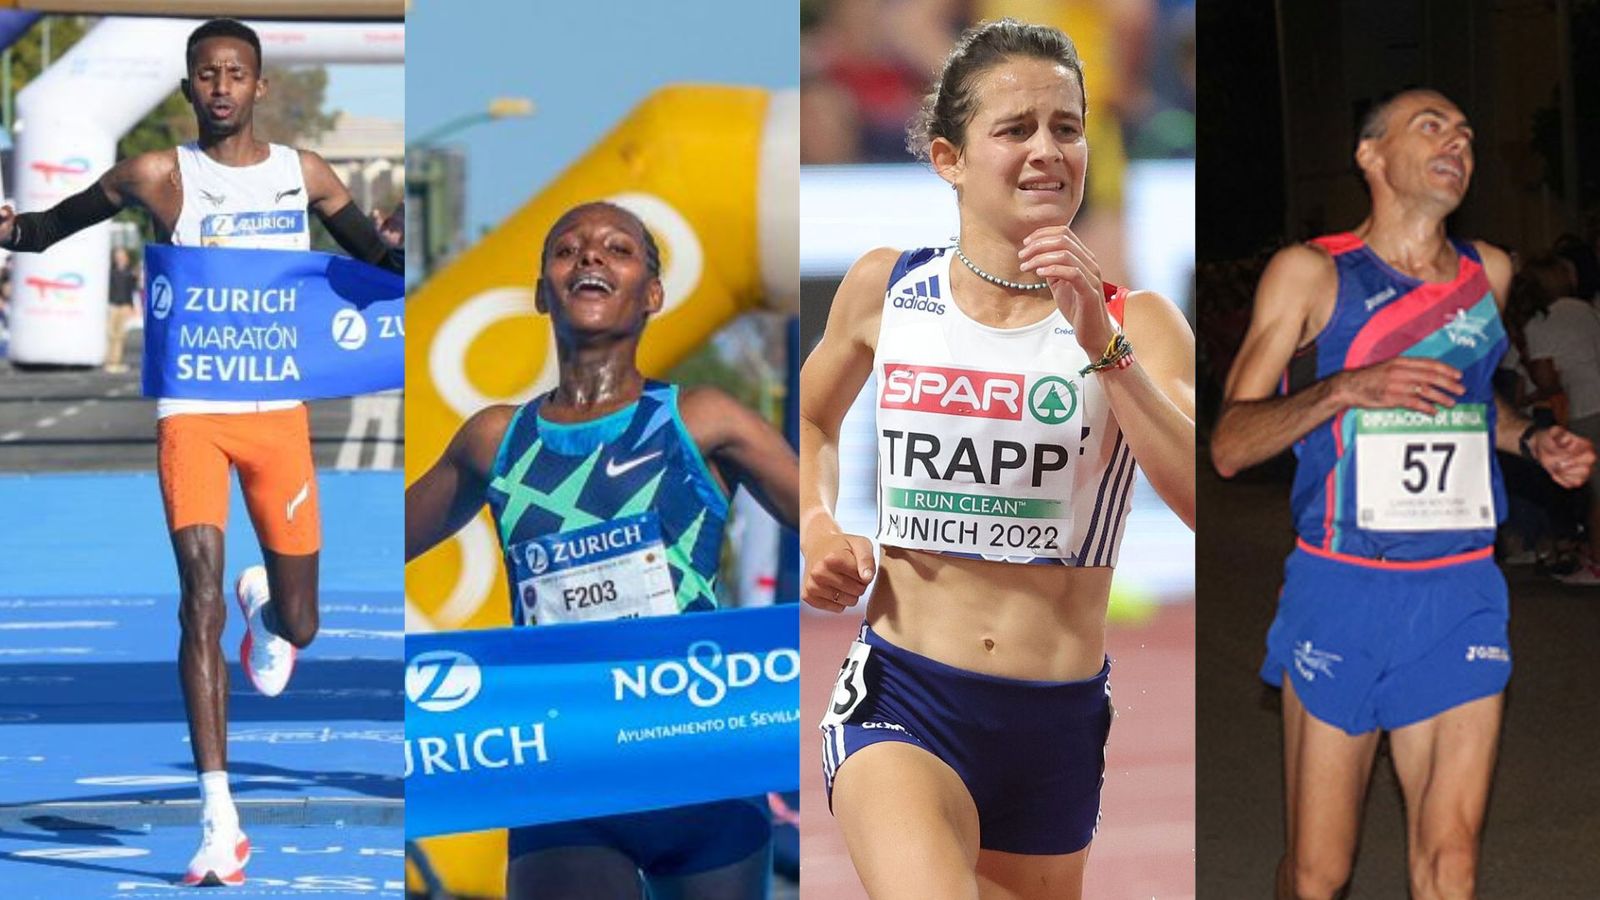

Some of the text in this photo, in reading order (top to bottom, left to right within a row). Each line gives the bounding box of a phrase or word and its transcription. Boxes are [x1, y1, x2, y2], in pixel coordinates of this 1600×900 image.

[239, 214, 296, 231] ZURICH
[184, 287, 297, 314] ZURICH
[893, 294, 946, 315] adidas
[179, 322, 297, 350] MARATÓN
[176, 354, 300, 381] SEVILLA
[884, 370, 1019, 414] SPAR
[883, 429, 1069, 487] TRAPP
[1401, 442, 1456, 494] 57
[904, 491, 909, 506] I
[915, 492, 958, 510] RUN
[552, 524, 642, 563] ZURICH
[887, 514, 1059, 549] MUNICH 2022
[563, 579, 617, 611] F203
